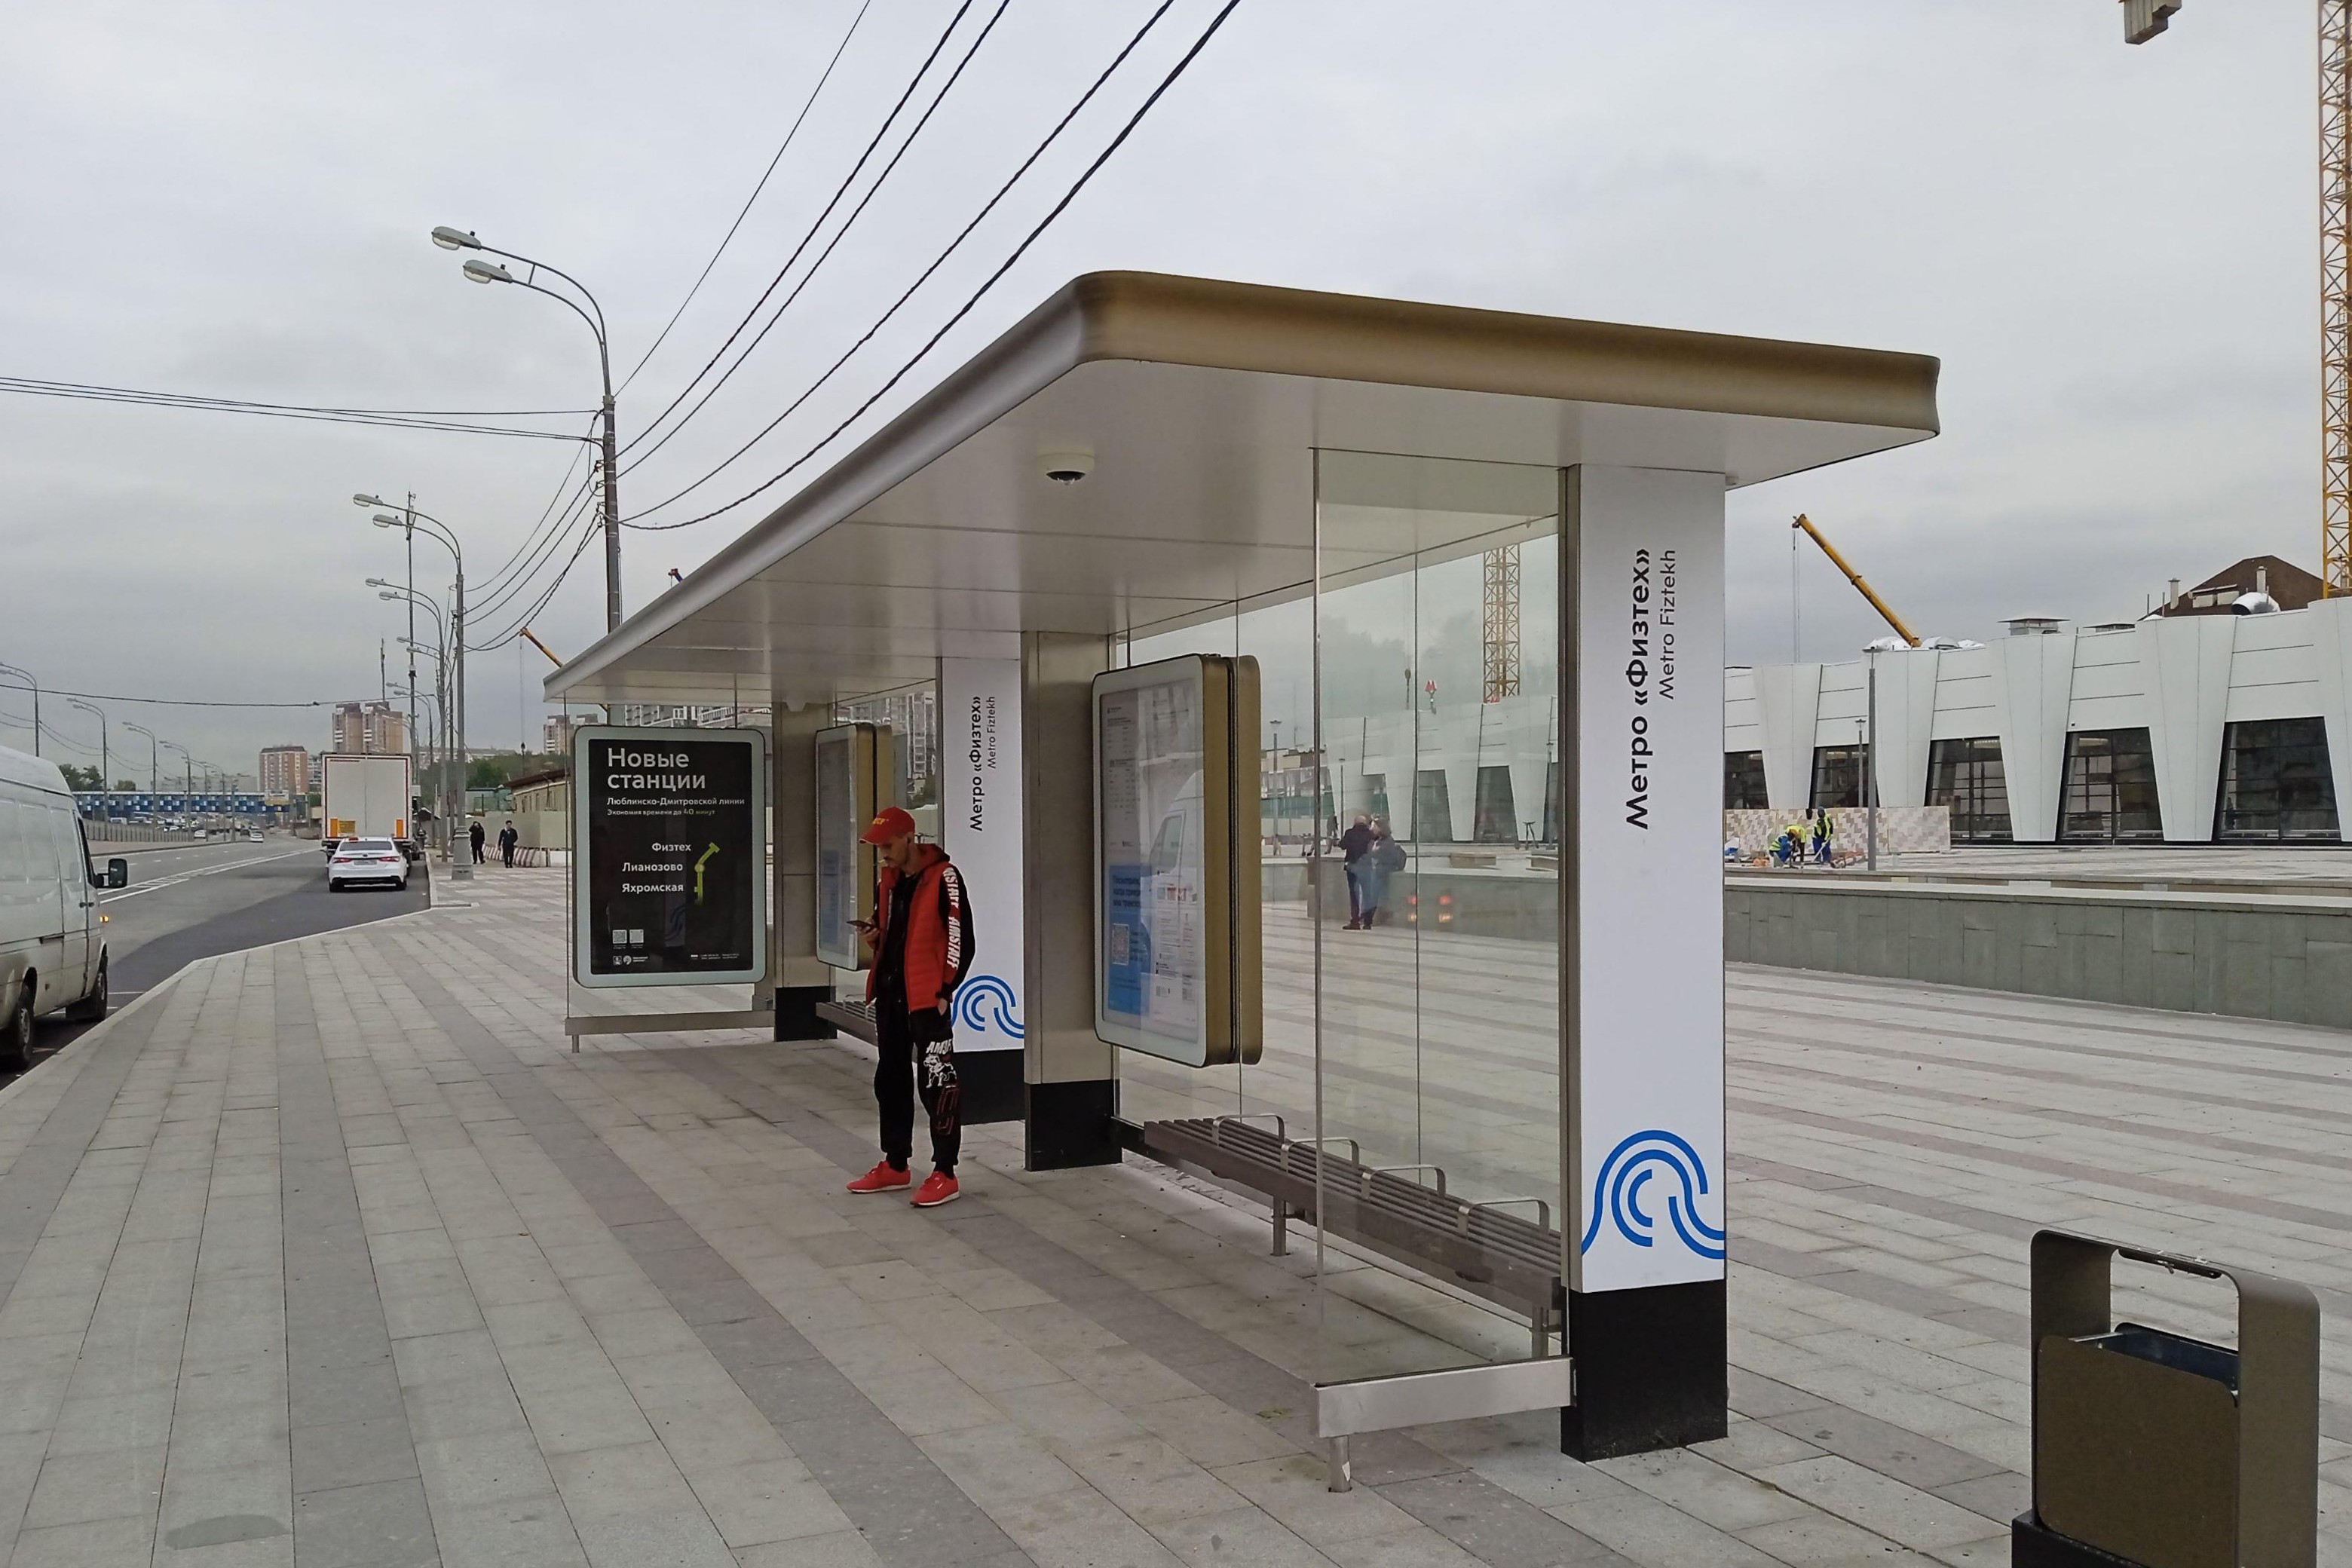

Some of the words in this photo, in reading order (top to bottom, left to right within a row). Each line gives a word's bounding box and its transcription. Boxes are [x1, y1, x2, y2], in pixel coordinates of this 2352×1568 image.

[1659, 550, 1676, 626] Fiztekh
[1625, 549, 1649, 706] «Физтех»
[1658, 633, 1675, 700] Metro
[986, 697, 996, 733] Fiztekh
[969, 696, 982, 772] «Физтех»
[608, 747, 690, 768] Новые
[987, 736, 997, 769] Metro
[607, 774, 706, 792] станции
[1625, 715, 1653, 830] Метро
[606, 797, 717, 807] Люблинско-Дмитровской
[969, 776, 985, 831] Метро
[651, 842, 692, 852] Физтех
[622, 862, 683, 872] Лианозово
[622, 883, 684, 895] Яхромская
[947, 915, 962, 971] AMSTAFF
